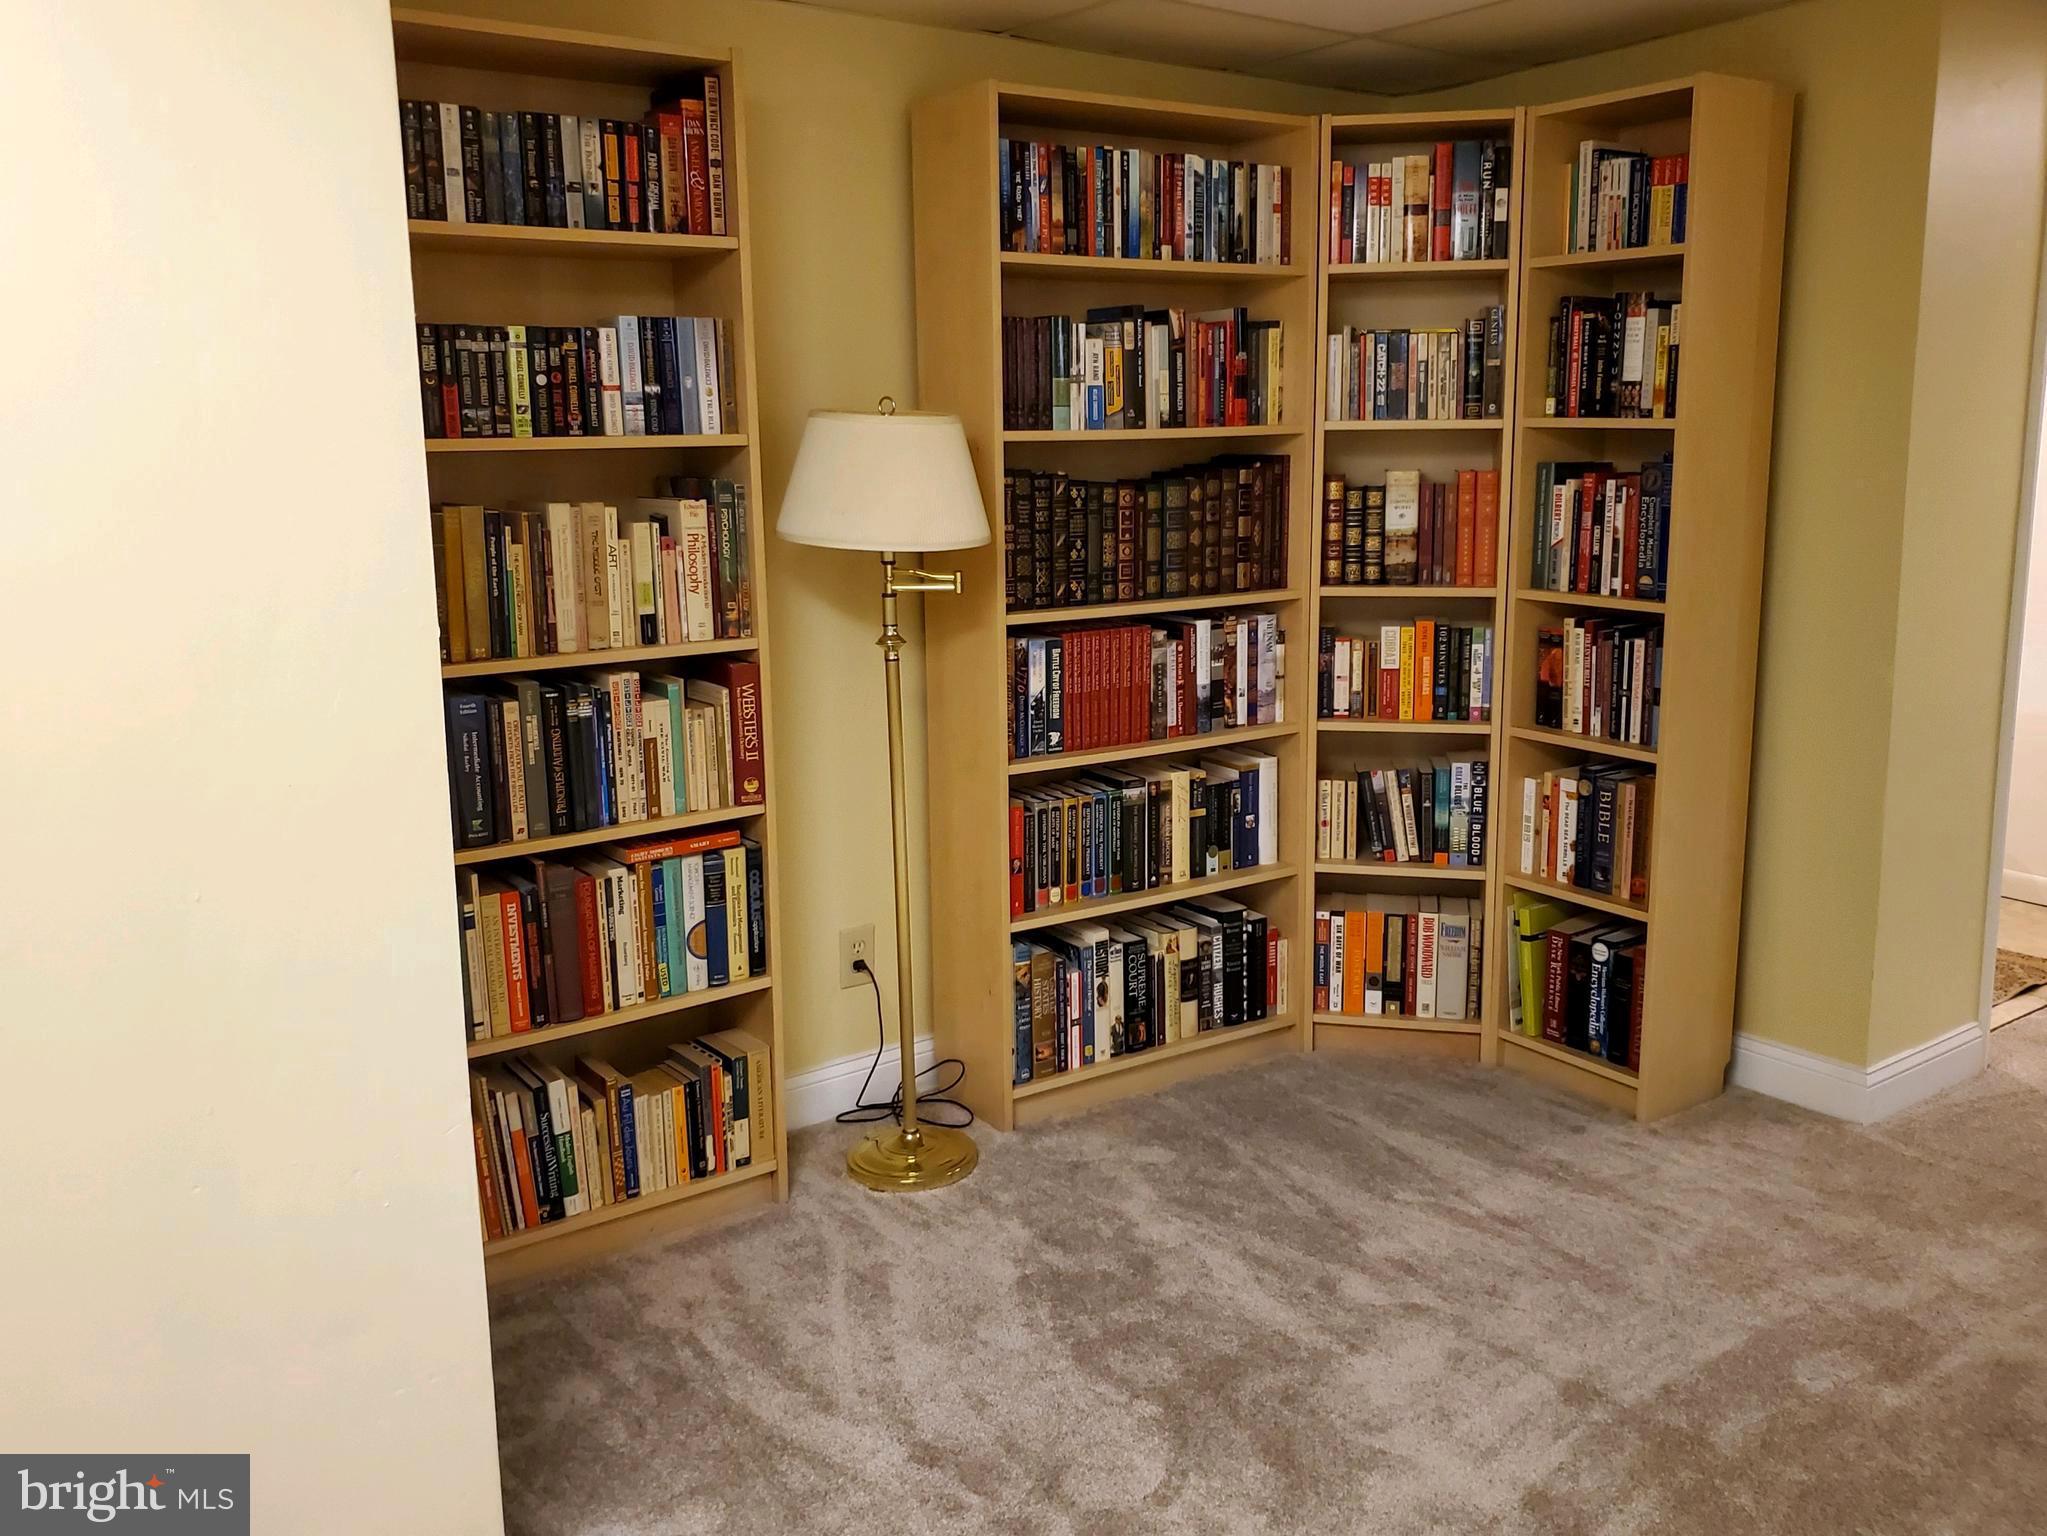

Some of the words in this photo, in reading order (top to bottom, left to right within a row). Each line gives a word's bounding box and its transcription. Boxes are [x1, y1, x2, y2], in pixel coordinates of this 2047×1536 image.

[707, 80, 717, 95] THE
[708, 97, 718, 108] DA
[709, 110, 719, 131] VINCI
[711, 134, 720, 153] CODE
[647, 152, 657, 169] JOHN
[713, 174, 722, 189] DAN
[1482, 162, 1492, 189] RUN
[648, 181, 659, 210] GRISHAM
[714, 192, 723, 219] BROWN
[1631, 193, 1640, 244] DICTIONARY
[1041, 229, 1048, 238] Pi
[1490, 308, 1498, 345] GENIUS
[461, 352, 471, 375] MICHAEL
[478, 353, 488, 377] MICHAEL
[494, 352, 504, 376] MICHAEL
[516, 350, 525, 373] MICHAEL
[569, 358, 578, 384] MICHAEL
[1376, 344, 1386, 392] CATCH-22
[463, 377, 473, 405] CONNELLY
[480, 379, 490, 406] CONNELLY
[496, 378, 506, 405] CONNELLY
[517, 374, 527, 400] CONNELLY
[570, 385, 580, 415] CONNELLY
[1554, 493, 1562, 521] DILBERT
[1647, 496, 1656, 535] Complete
[721, 508, 731, 559] PSYCHOLOGY
[1638, 496, 1649, 568] Encyclopedia
[489, 536, 498, 557] People
[608, 545, 618, 570] ART
[1646, 537, 1654, 569] Medical
[491, 567, 499, 576] the
[686, 533, 702, 595] Philosophy
[492, 577, 500, 597] Earth
[1384, 630, 1398, 656] COBRA
[1439, 626, 1448, 641] 102
[1052, 648, 1061, 669] BATTLE
[1052, 670, 1061, 682] CRY
[741, 683, 760, 749] WEBSTER'S
[1052, 691, 1061, 719] FREEDOM
[470, 731, 481, 772] Intermediate
[511, 720, 522, 781] ORGANIZATIONAL
[616, 731, 624, 756] MUSTANG
[745, 751, 760, 762] II
[474, 774, 485, 812] Accounting
[555, 773, 569, 815] PRINCIPLES
[1473, 787, 1483, 813] BLUE
[1597, 790, 1612, 844] BIBLE
[1471, 823, 1482, 855] BLOOD
[617, 876, 626, 916] Marketing
[1423, 917, 1434, 932] BOB
[507, 903, 523, 982] INVESTMENTS
[581, 882, 594, 938] FOUNDATIONS
[588, 952, 600, 1000] MARKETING
[1213, 935, 1222, 969] CITIZEN
[1095, 941, 1109, 978] HISTORY
[1421, 934, 1434, 979] WOODWARD
[659, 968, 668, 987] USED
[1128, 954, 1138, 998] COURT
[1137, 953, 1146, 1007] SUPREME
[1352, 950, 1360, 995] POSTWAR
[1033, 978, 1042, 1019] HISTORY
[1214, 982, 1223, 1018] HUGHES
[1589, 963, 1601, 1035] Encyclopedia
[621, 1098, 631, 1113] Au
[623, 1115, 632, 1125] Fil
[539, 1112, 556, 1161] Successful
[623, 1127, 632, 1143] des
[625, 1145, 635, 1170] Jours
[547, 1160, 561, 1199] Writing
